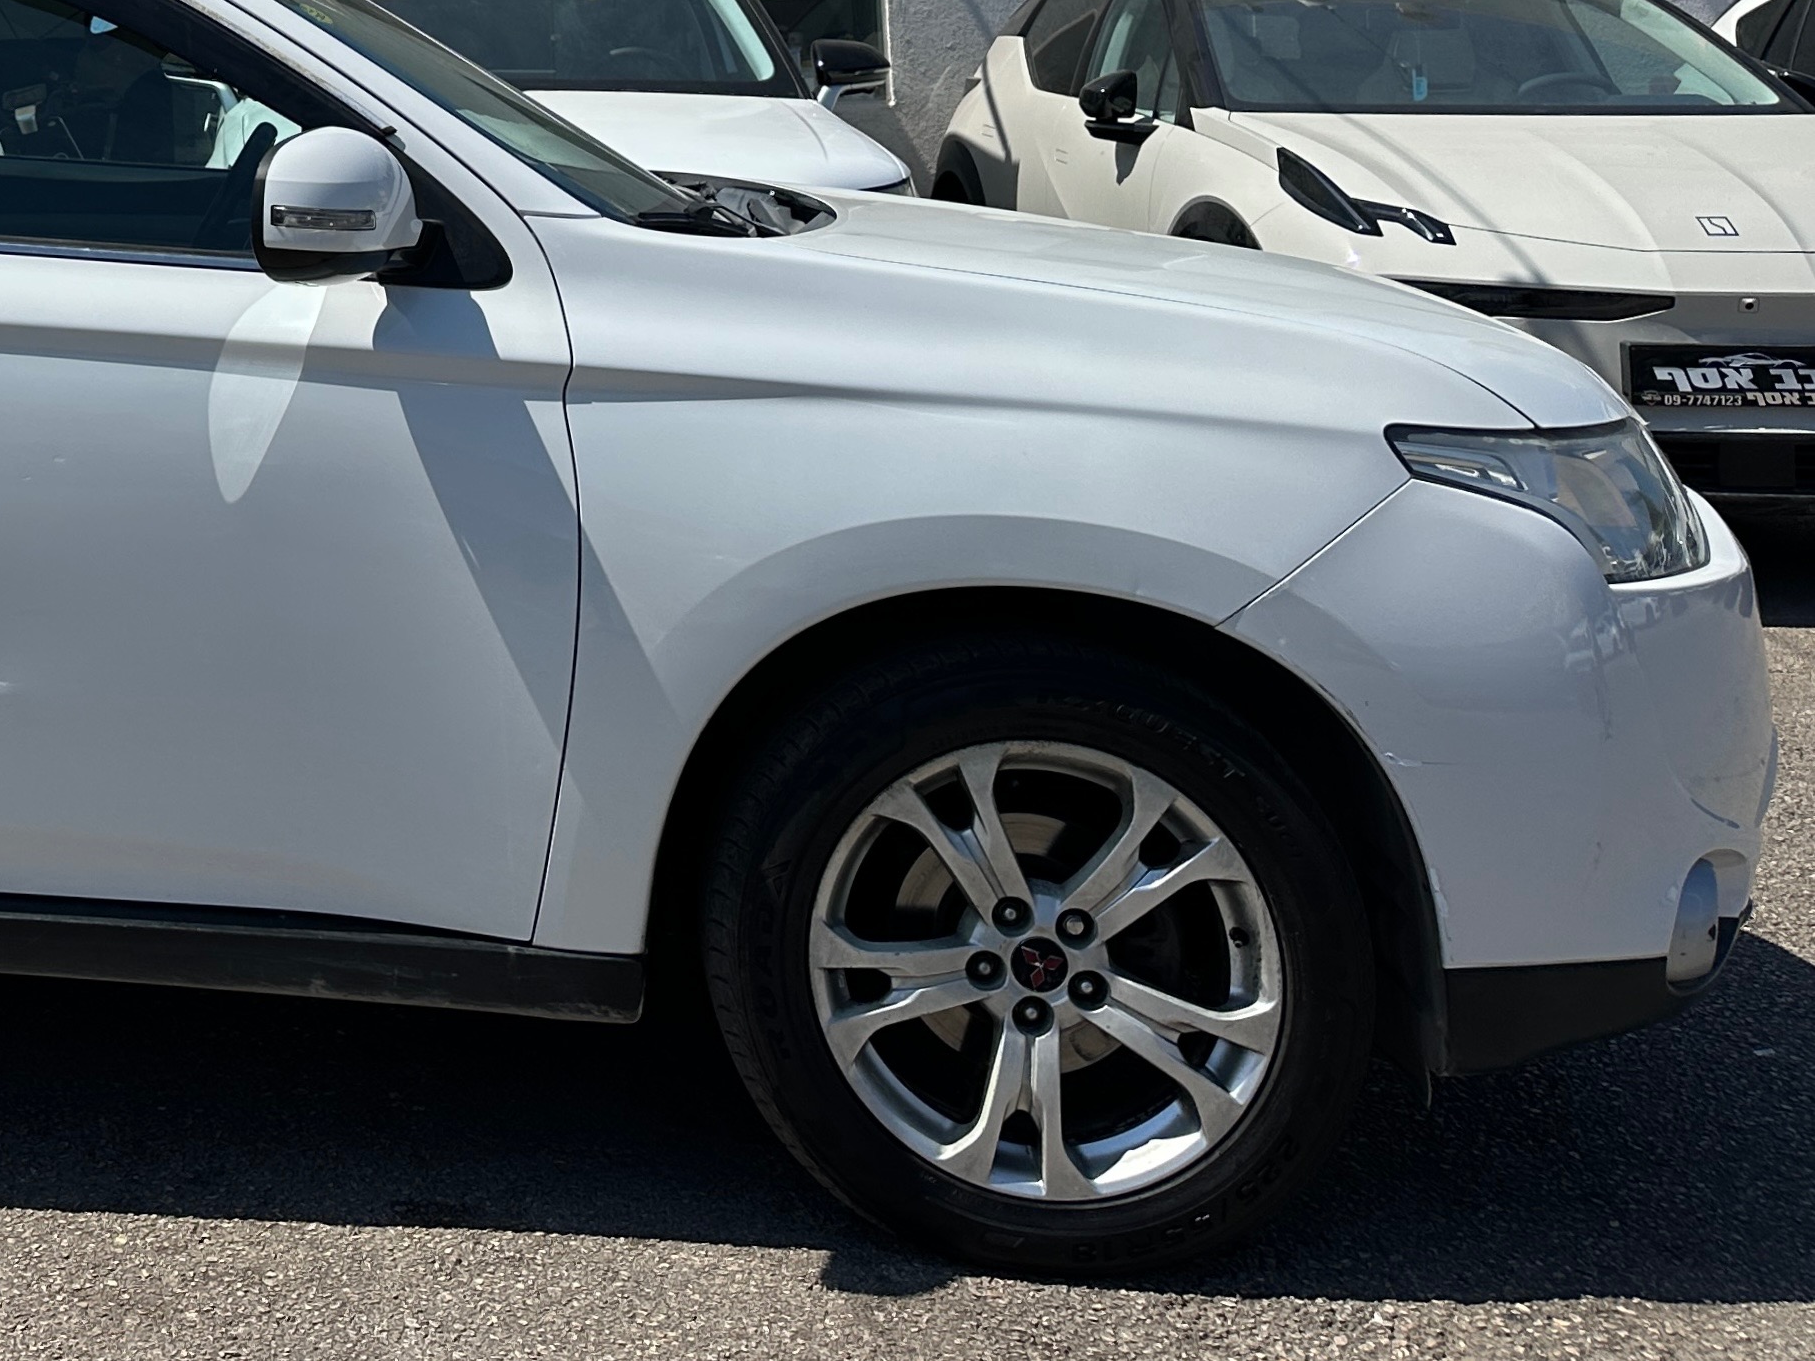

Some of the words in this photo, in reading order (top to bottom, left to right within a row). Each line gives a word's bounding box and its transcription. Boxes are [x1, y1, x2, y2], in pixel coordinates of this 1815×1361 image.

[1652, 365, 1759, 393] אסף
[1664, 393, 1742, 407] 09-7747123
[1745, 390, 1802, 407] אסף
